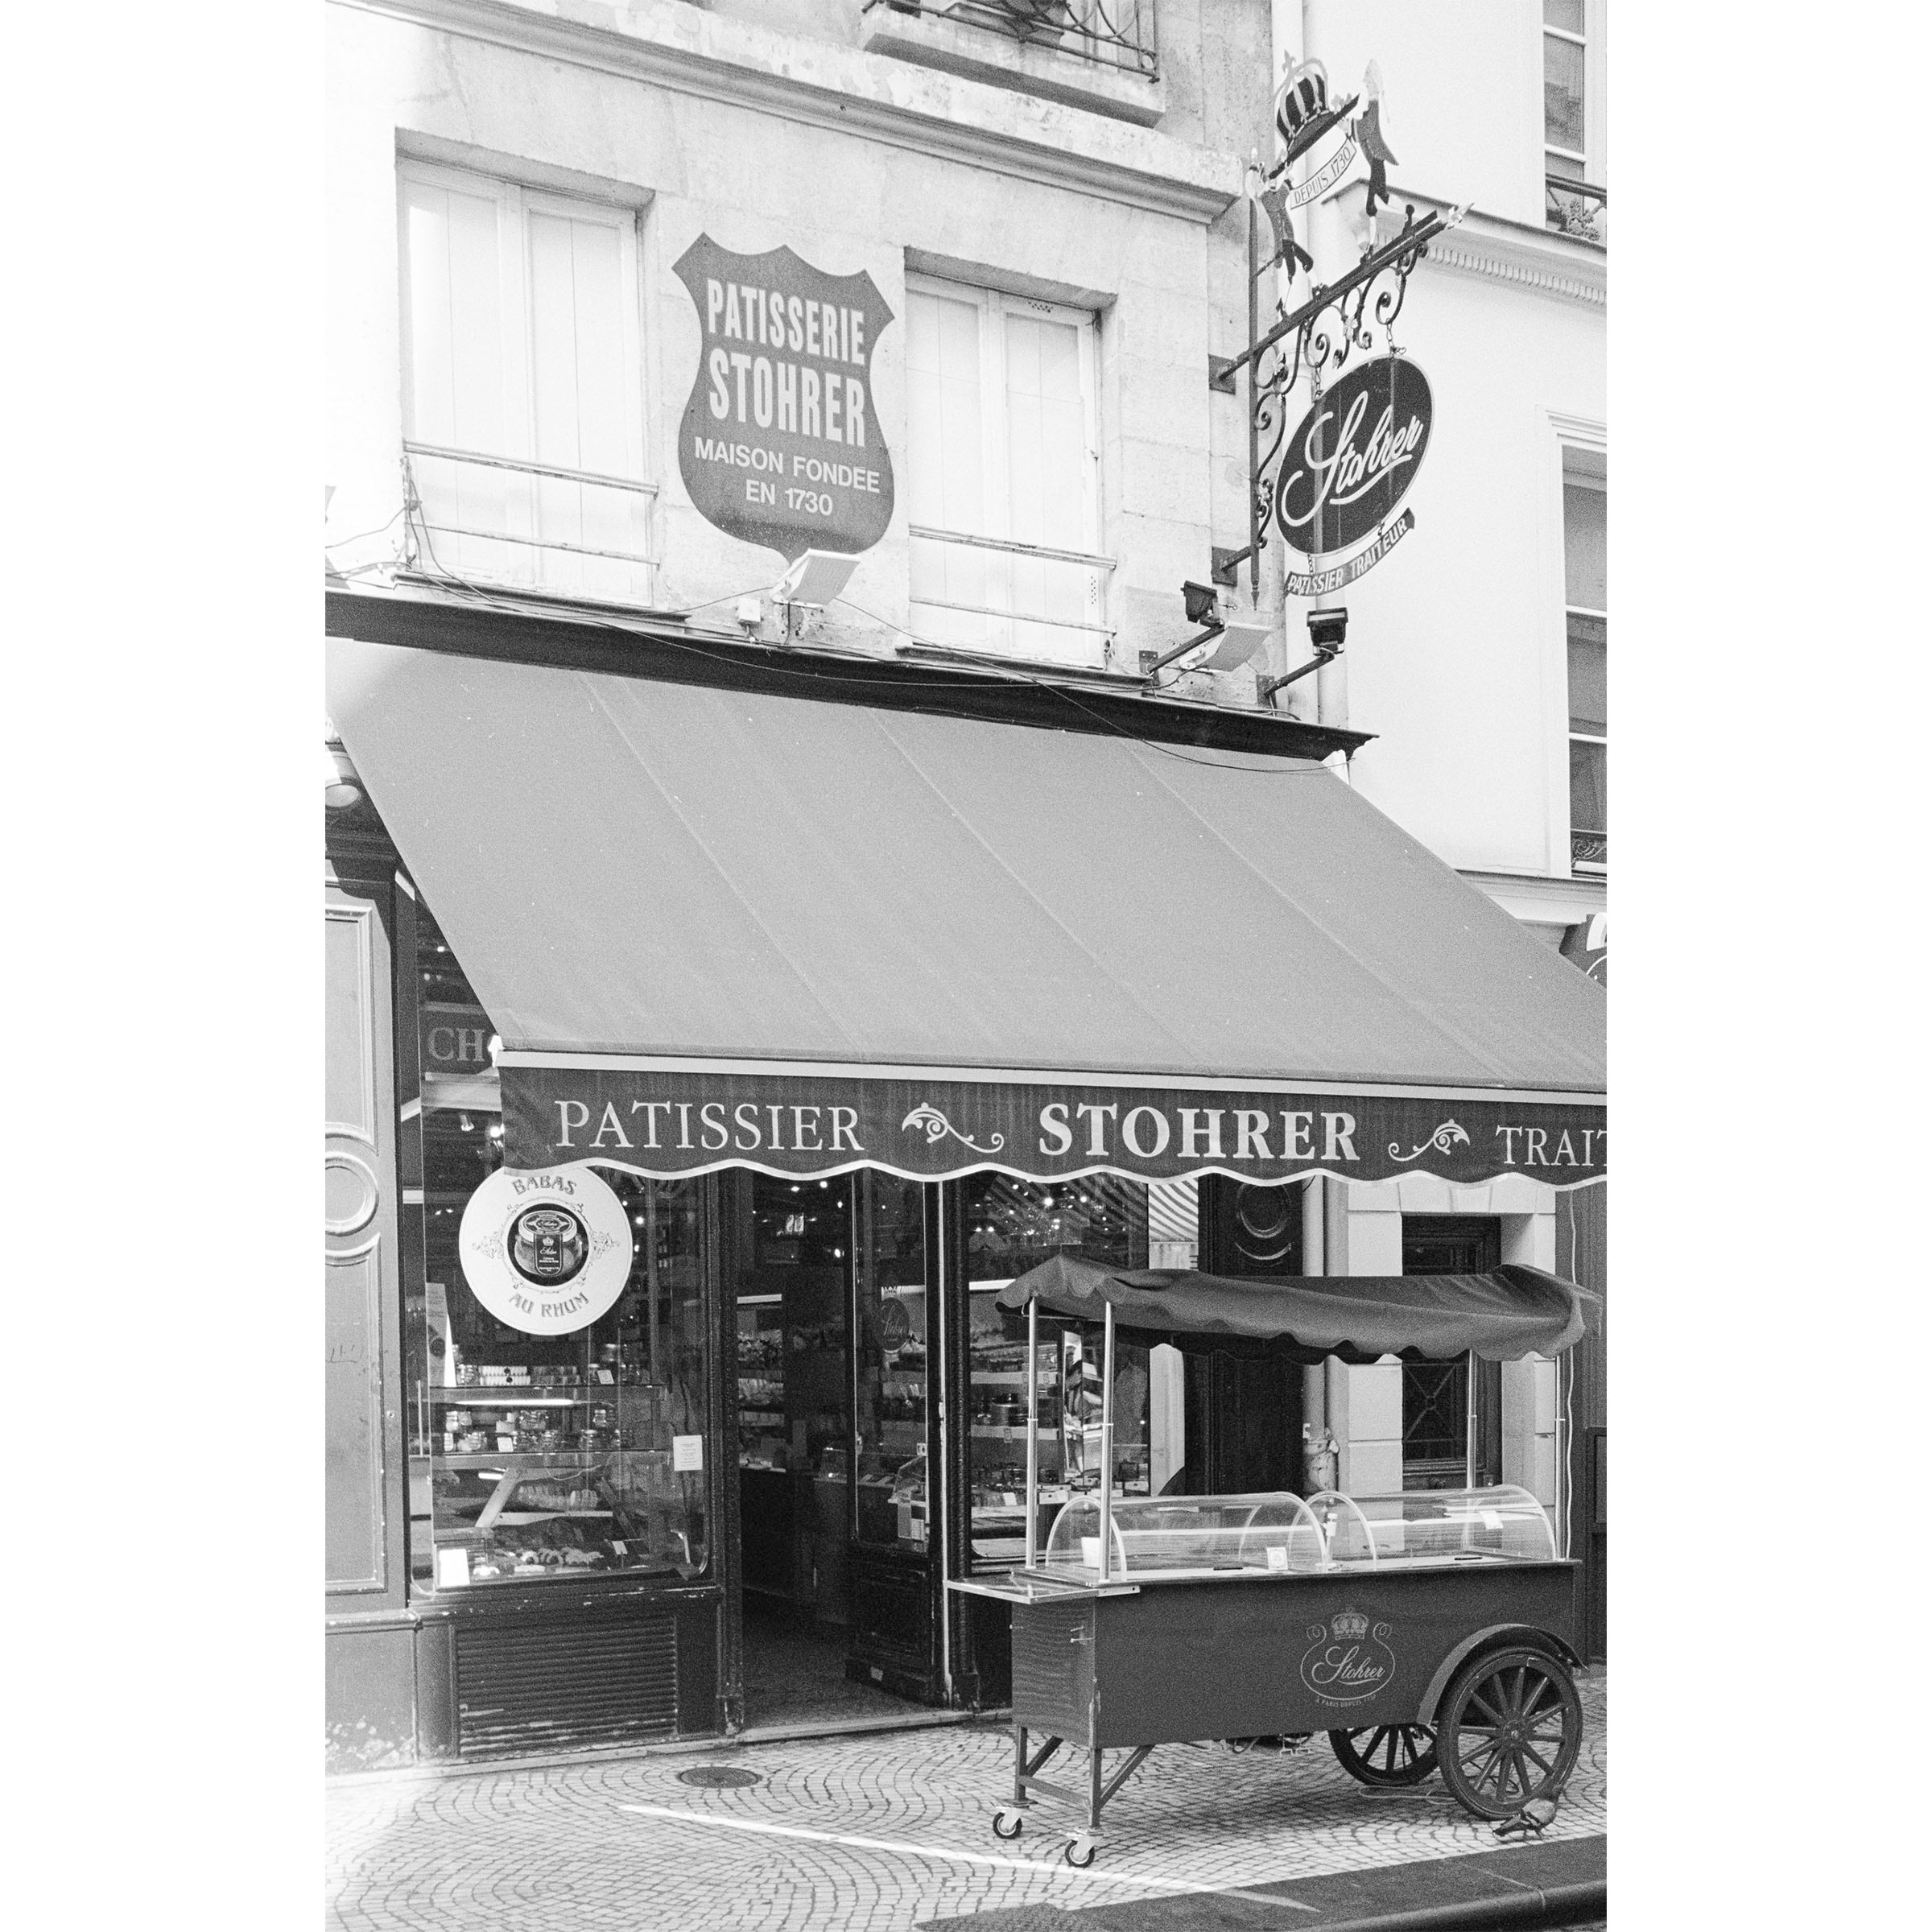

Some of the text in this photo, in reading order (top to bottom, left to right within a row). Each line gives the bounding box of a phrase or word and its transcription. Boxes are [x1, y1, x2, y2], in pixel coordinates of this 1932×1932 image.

[1294, 147, 1351, 204] DEPUIS 1730
[707, 279, 865, 366] PATISSERIE
[709, 347, 865, 448] STOHRER
[695, 436, 783, 474] MAISON
[1282, 390, 1423, 527] Stohrer
[745, 479, 833, 516] EN 1730
[1287, 518, 1408, 596] PATISSIER TRAITEUR
[428, 1026, 485, 1062] CH
[554, 1100, 865, 1151] PATISSIER
[1039, 1102, 1360, 1161] STOHRER
[511, 1174, 577, 1195] BABAS
[509, 1292, 589, 1318] AU RHUM
[1311, 1645, 1385, 1684] Stohrer
